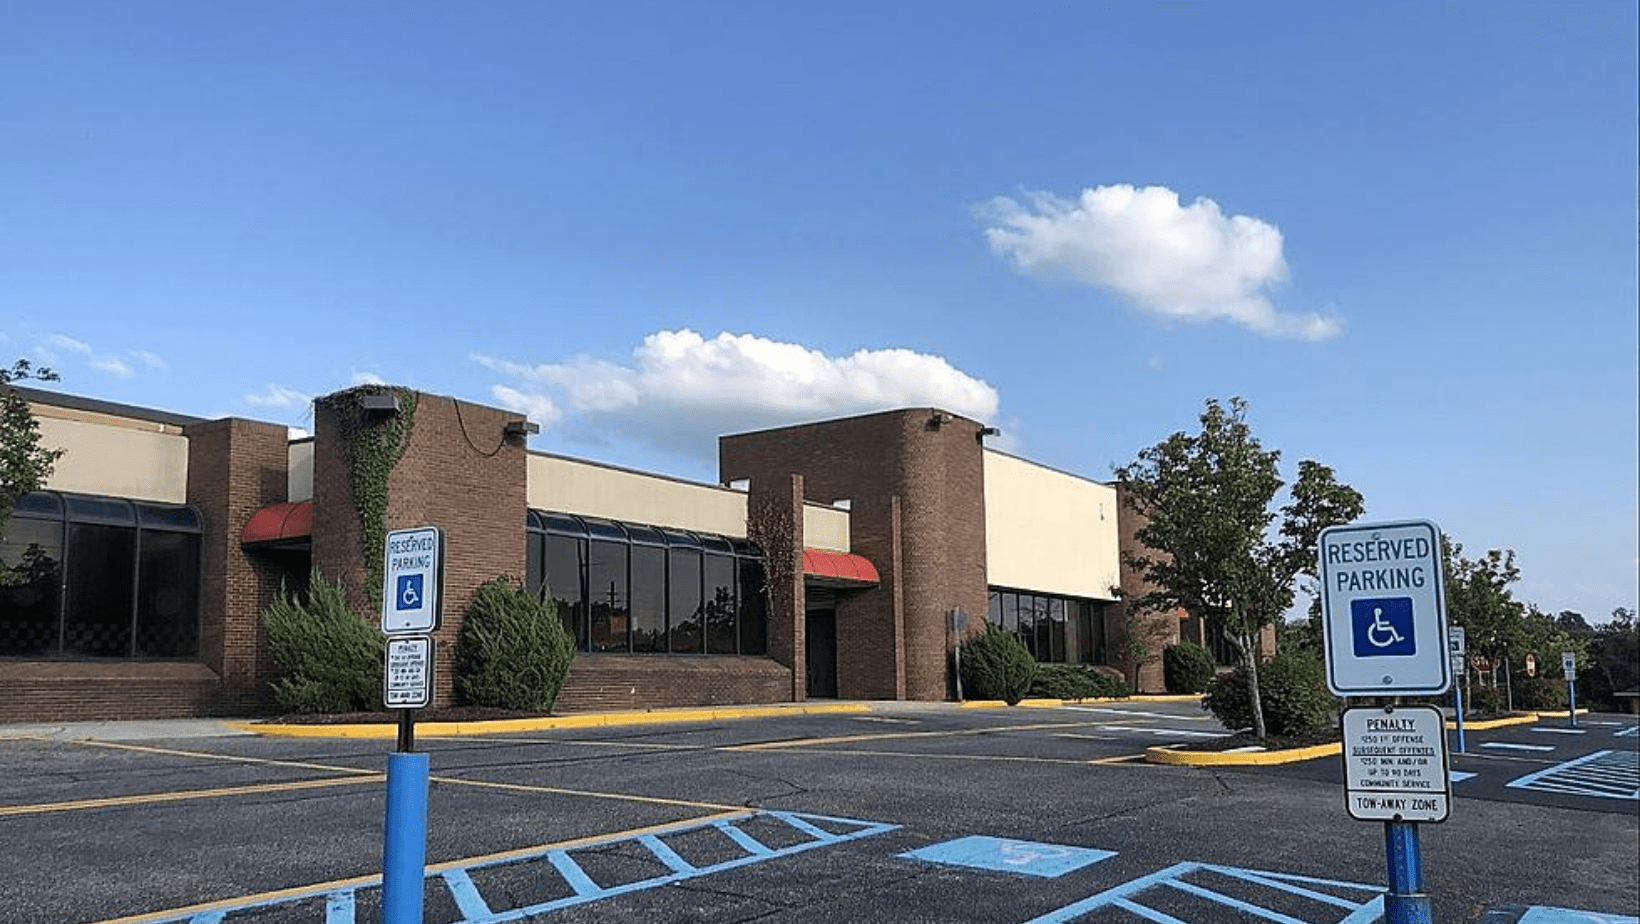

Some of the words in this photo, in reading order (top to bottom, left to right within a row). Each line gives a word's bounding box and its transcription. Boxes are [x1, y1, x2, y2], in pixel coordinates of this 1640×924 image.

[390, 537, 433, 554] RESERVED
[1328, 538, 1430, 564] RESERVED
[392, 555, 431, 571] PARKING
[1337, 567, 1425, 591] PARKING
[1366, 719, 1415, 730] PENALTY
[1392, 735, 1424, 744] OFFENSE
[1357, 798, 1406, 810] TOW-AWAY
[1412, 799, 1438, 811] ZONE
